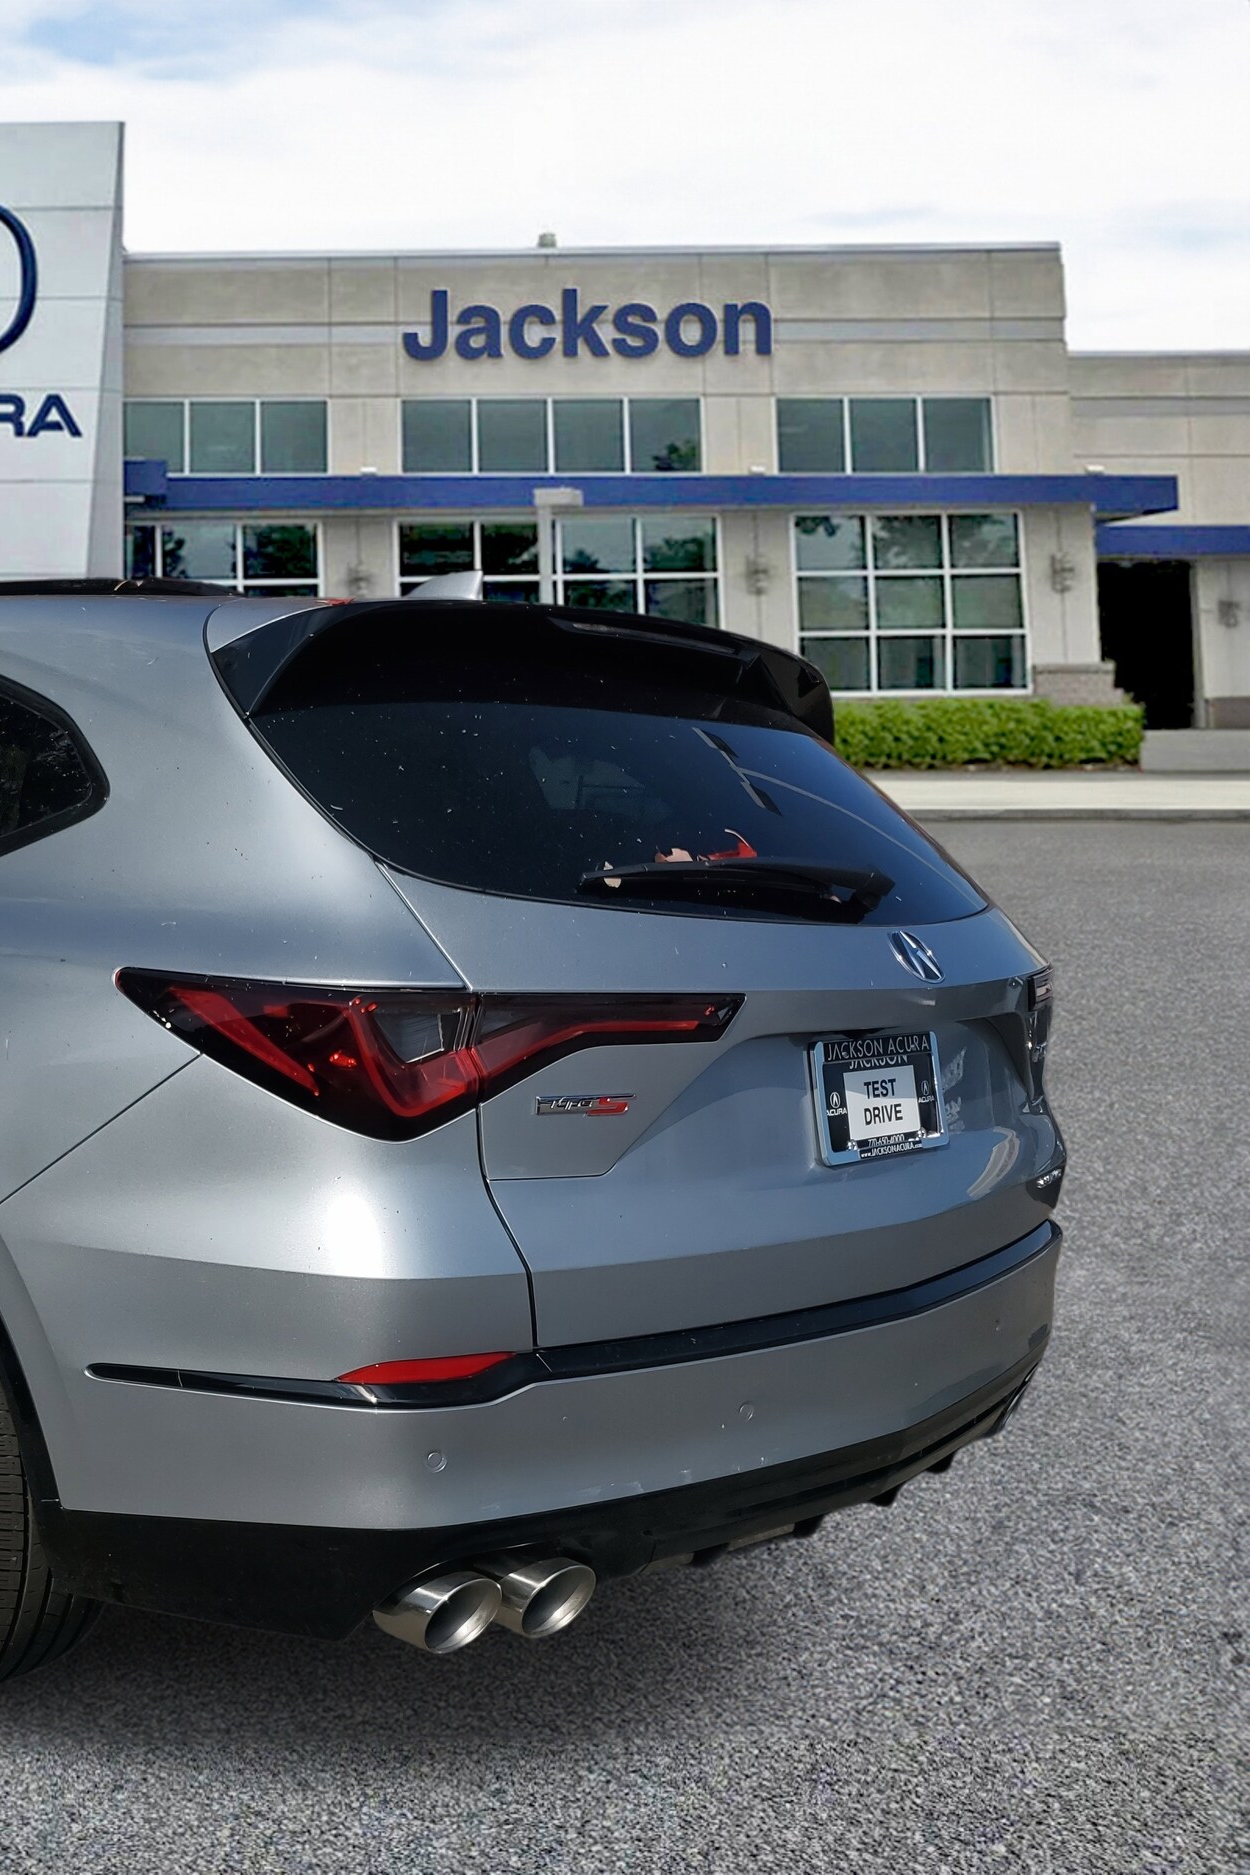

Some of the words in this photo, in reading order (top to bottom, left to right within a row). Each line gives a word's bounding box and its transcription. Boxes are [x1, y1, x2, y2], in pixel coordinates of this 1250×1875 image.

[403, 288, 773, 361] Jackson
[828, 1038, 883, 1061] JACKSON
[888, 1035, 930, 1054] ACURA
[863, 1078, 896, 1099] TEST
[864, 1103, 903, 1126] DRIVE
